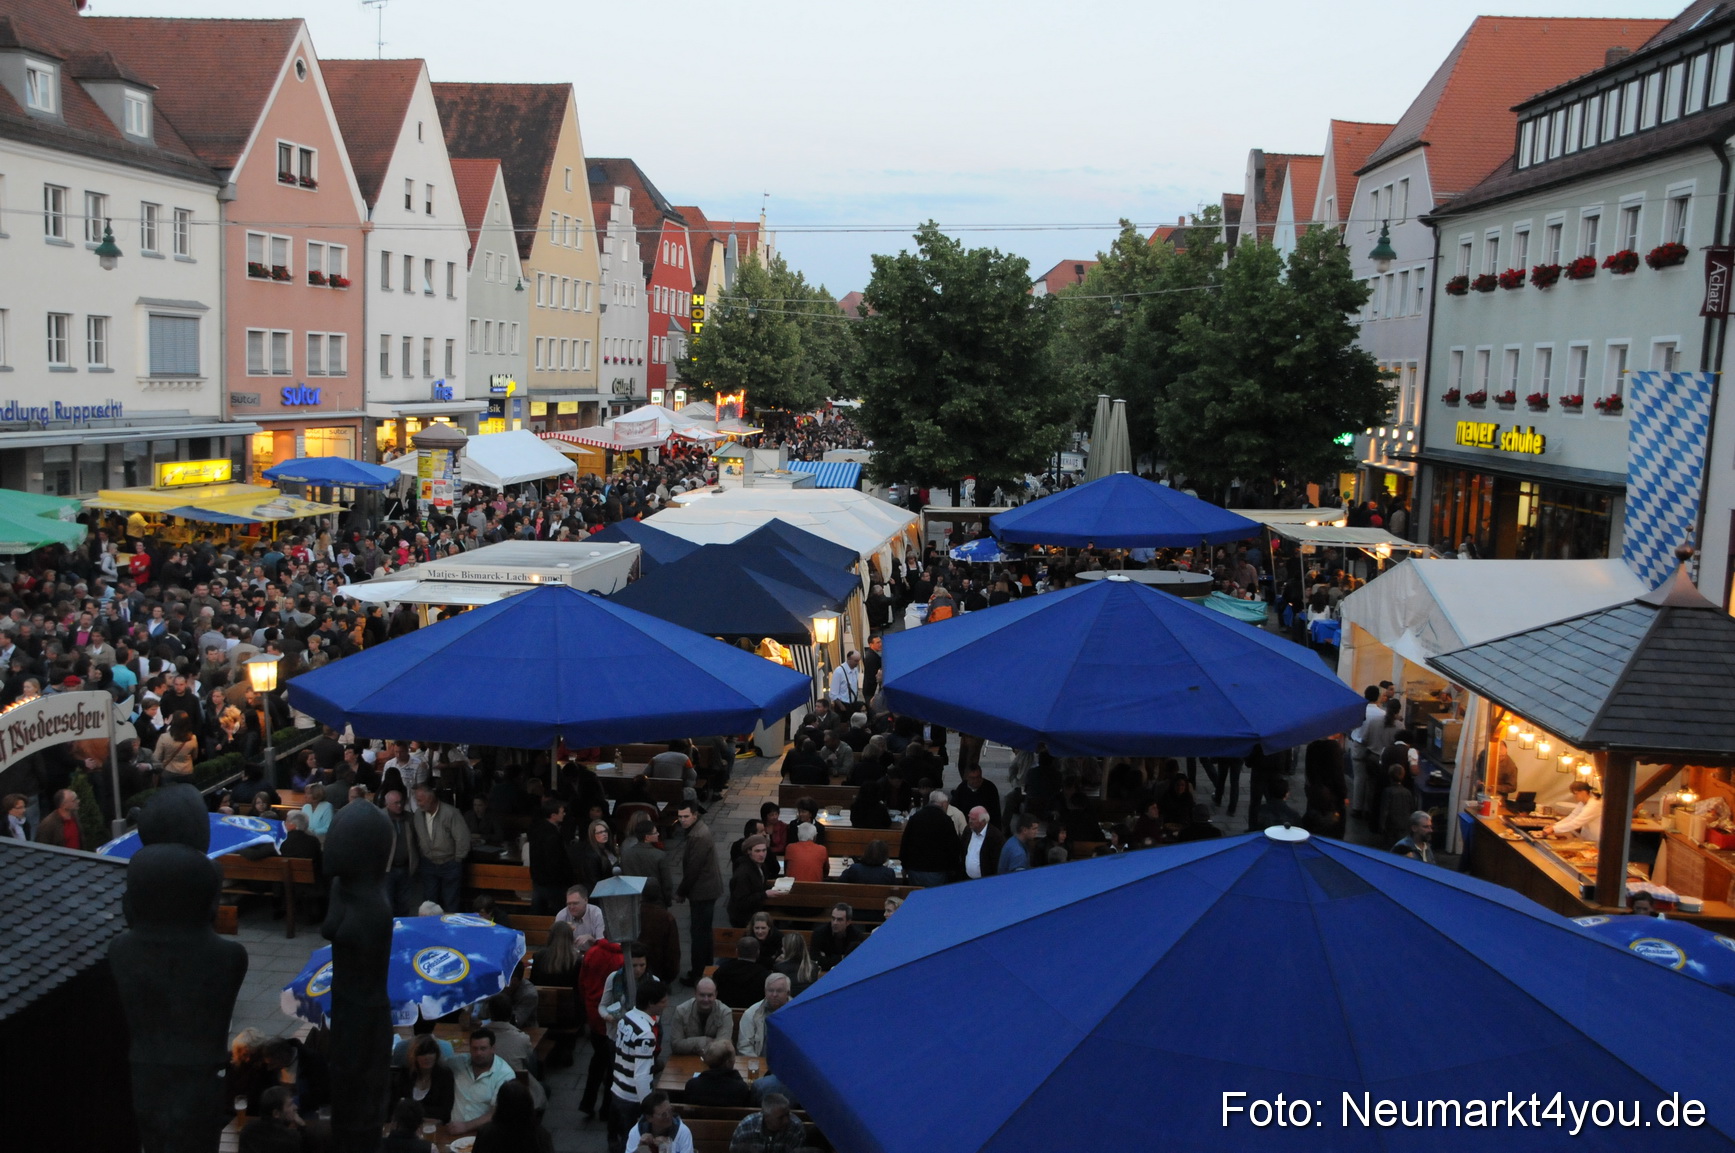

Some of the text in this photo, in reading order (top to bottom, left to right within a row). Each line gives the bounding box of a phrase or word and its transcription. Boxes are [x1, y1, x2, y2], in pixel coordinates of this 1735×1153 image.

[1708, 261, 1727, 312] Achatz
[230, 395, 258, 405] sutor
[282, 382, 322, 406] sutor
[54, 399, 123, 424] Rupprecht
[488, 404, 501, 413] sik
[1455, 421, 1546, 454] mayer schuhe
[427, 569, 459, 580] Matjes-
[461, 570, 504, 581] Bismarck-
